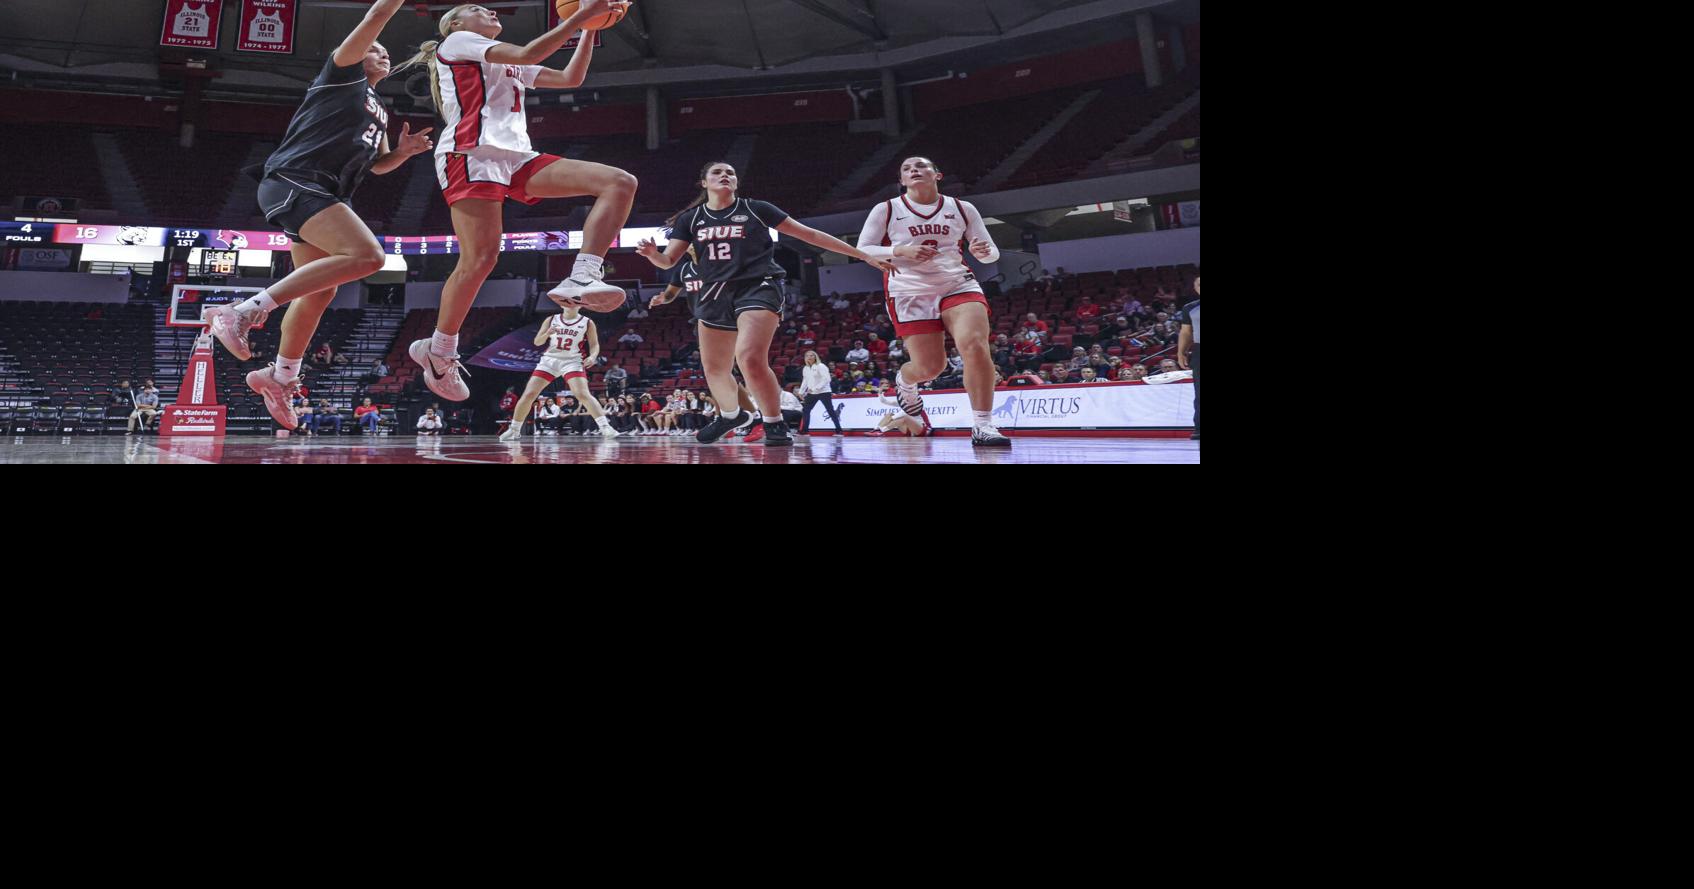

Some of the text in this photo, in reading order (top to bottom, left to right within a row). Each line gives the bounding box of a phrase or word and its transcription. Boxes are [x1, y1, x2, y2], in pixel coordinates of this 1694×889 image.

[180, 11, 206, 19] ILLINOIS
[184, 17, 199, 26] 21
[255, 18, 280, 26] ILLINOIS
[259, 24, 275, 32] 00
[511, 86, 521, 112] 1
[362, 122, 383, 149] 21
[21, 223, 32, 233] 4
[76, 227, 98, 239] 16
[697, 225, 744, 241] SIUE
[908, 224, 950, 237] BIRDS
[174, 230, 199, 239] 1:19
[267, 234, 288, 246] 19
[177, 239, 195, 247] 1ST
[707, 242, 732, 260] 12
[556, 337, 573, 351] 12
[1020, 397, 1081, 415] VIRTUS
